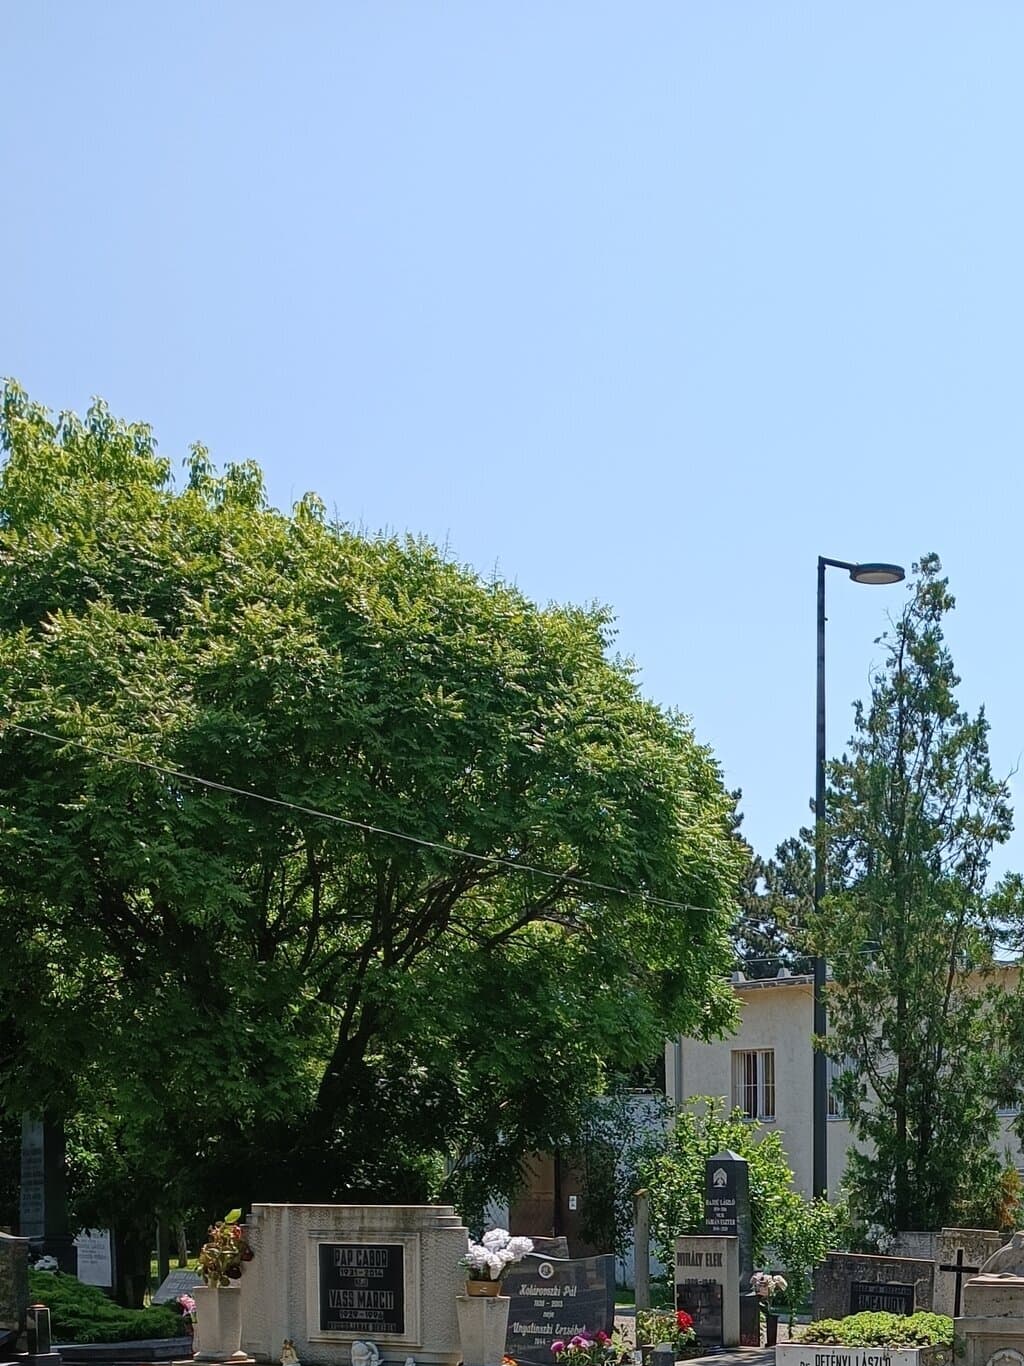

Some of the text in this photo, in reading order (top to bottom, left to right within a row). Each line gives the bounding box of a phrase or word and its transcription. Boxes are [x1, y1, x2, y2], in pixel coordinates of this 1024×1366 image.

[335, 1249, 353, 1267] PAP
[705, 1252, 723, 1267] ELEK
[563, 1284, 577, 1297] Pál
[329, 1290, 354, 1309] VASS
